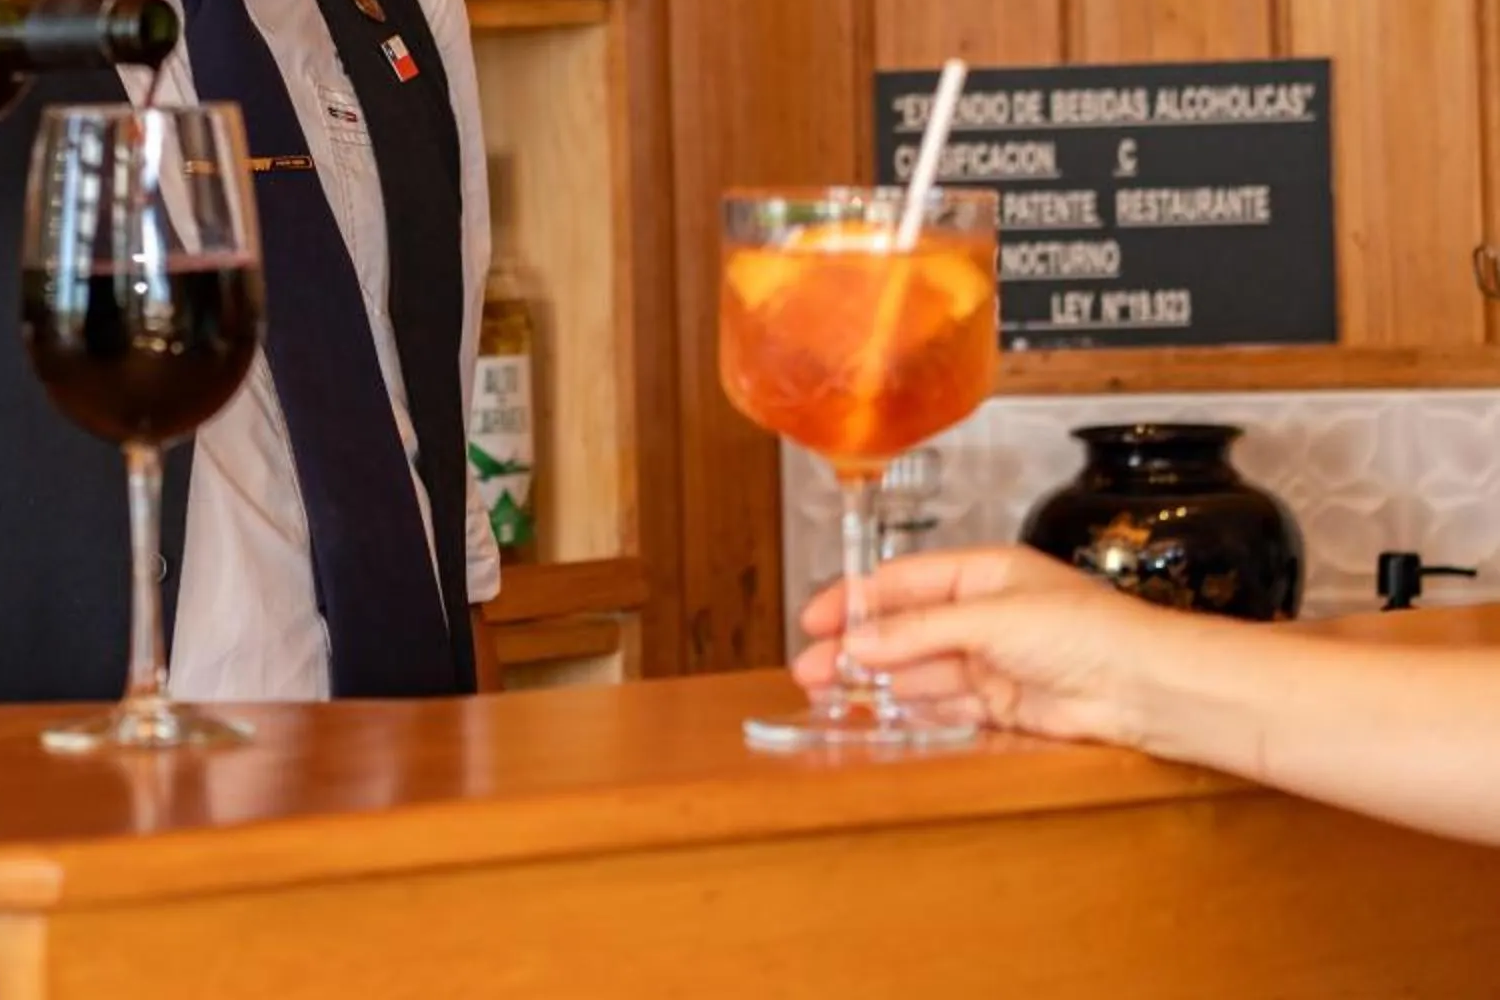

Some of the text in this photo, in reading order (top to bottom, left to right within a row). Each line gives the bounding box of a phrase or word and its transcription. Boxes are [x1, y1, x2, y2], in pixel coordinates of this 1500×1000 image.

[893, 90, 1010, 125] "EXNDIO
[1013, 89, 1043, 123] DE
[1051, 87, 1148, 122] BEBIDAS
[894, 137, 1138, 177] CSIFICACION C
[1003, 189, 1098, 224] PATENTE
[1116, 185, 1270, 223] RESTAURANTE
[1000, 239, 1121, 275] NOCTURNO
[1051, 291, 1095, 324] LEY
